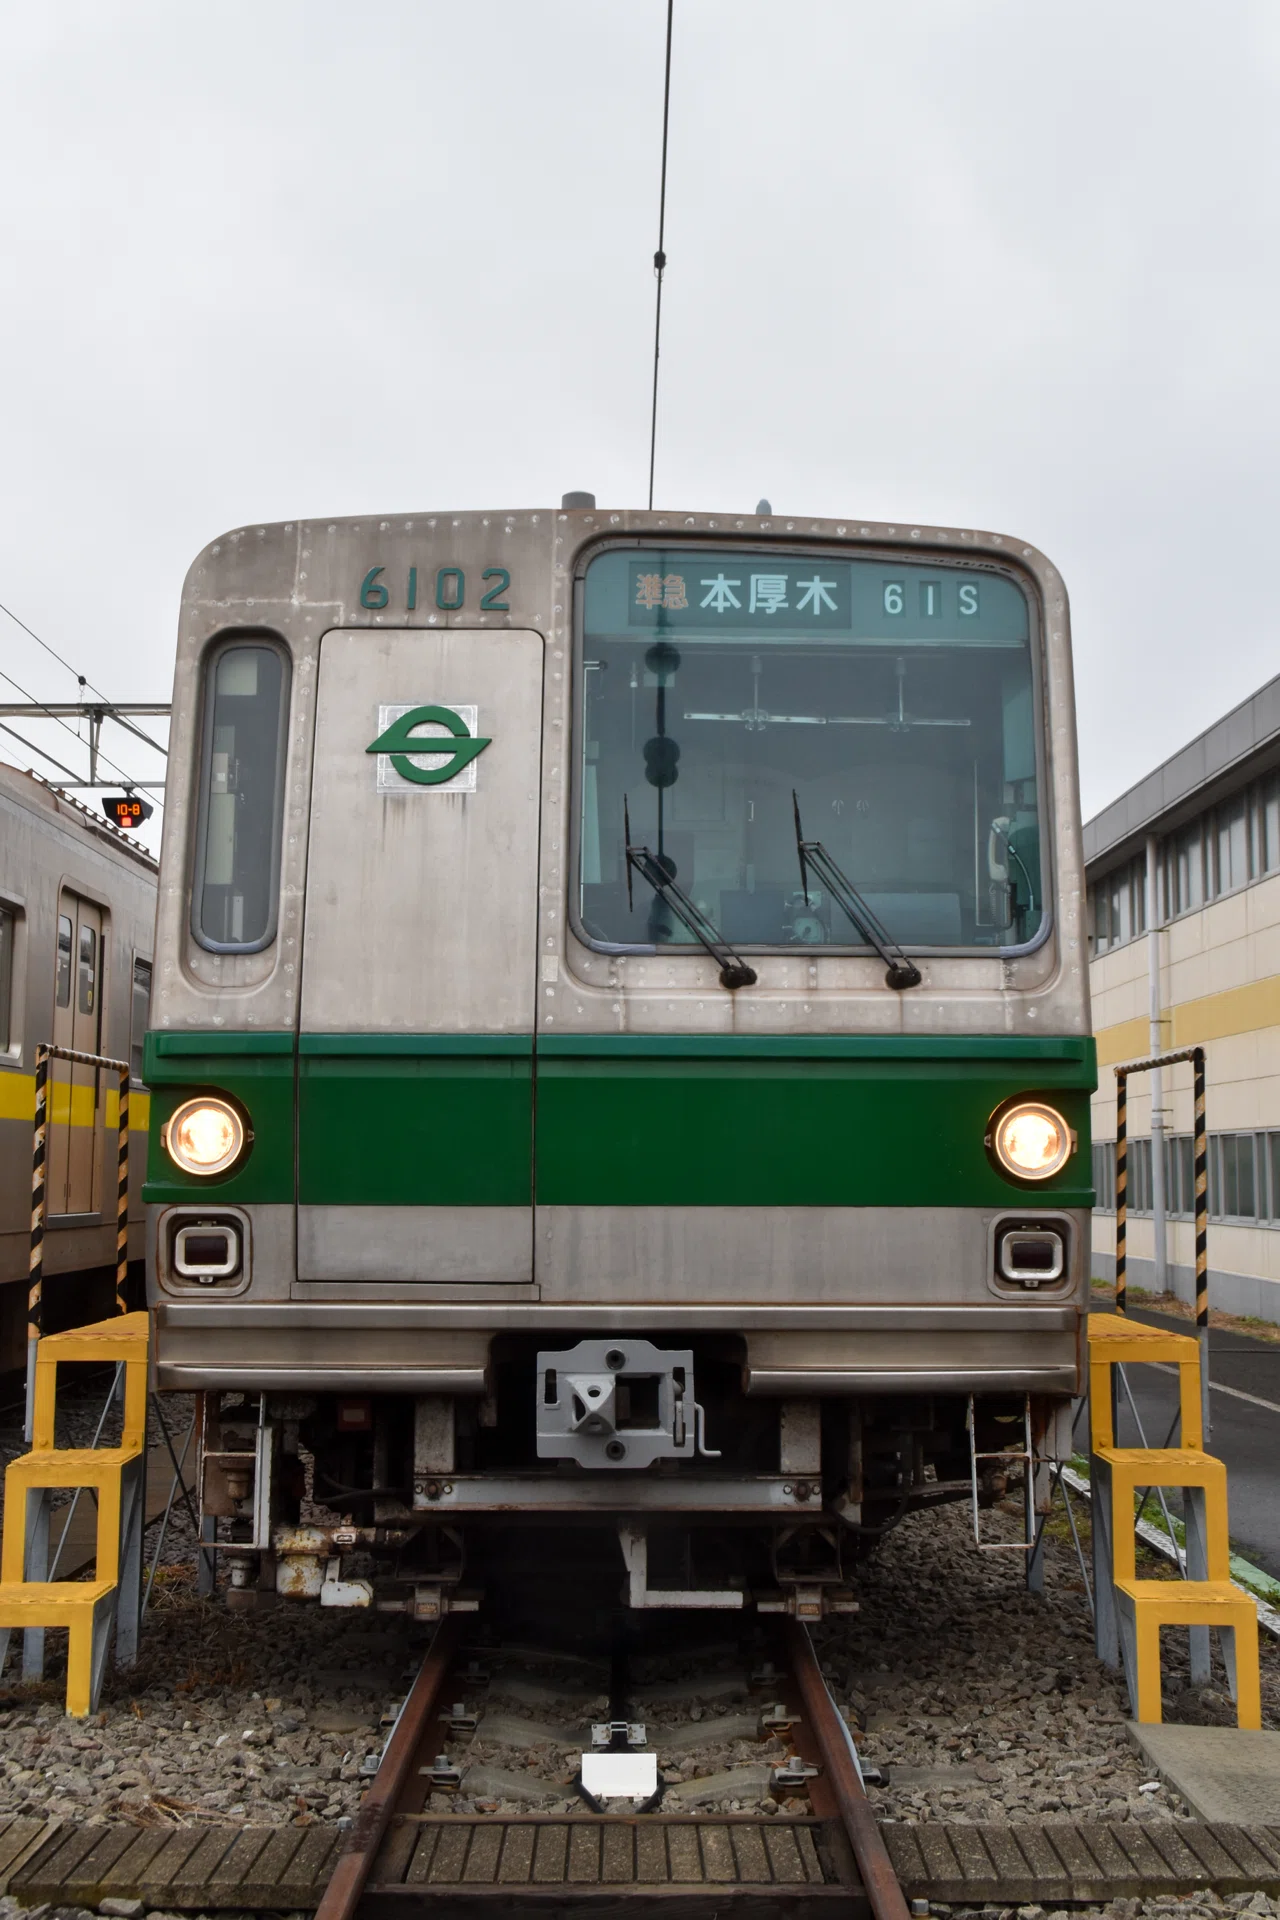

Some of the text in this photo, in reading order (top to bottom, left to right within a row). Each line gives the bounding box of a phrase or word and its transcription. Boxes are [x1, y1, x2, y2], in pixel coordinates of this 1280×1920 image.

[360, 566, 511, 611] 6102
[635, 573, 838, 615] 準急 本厚木
[884, 584, 978, 616] 61S
[117, 803, 140, 816] 10-8
